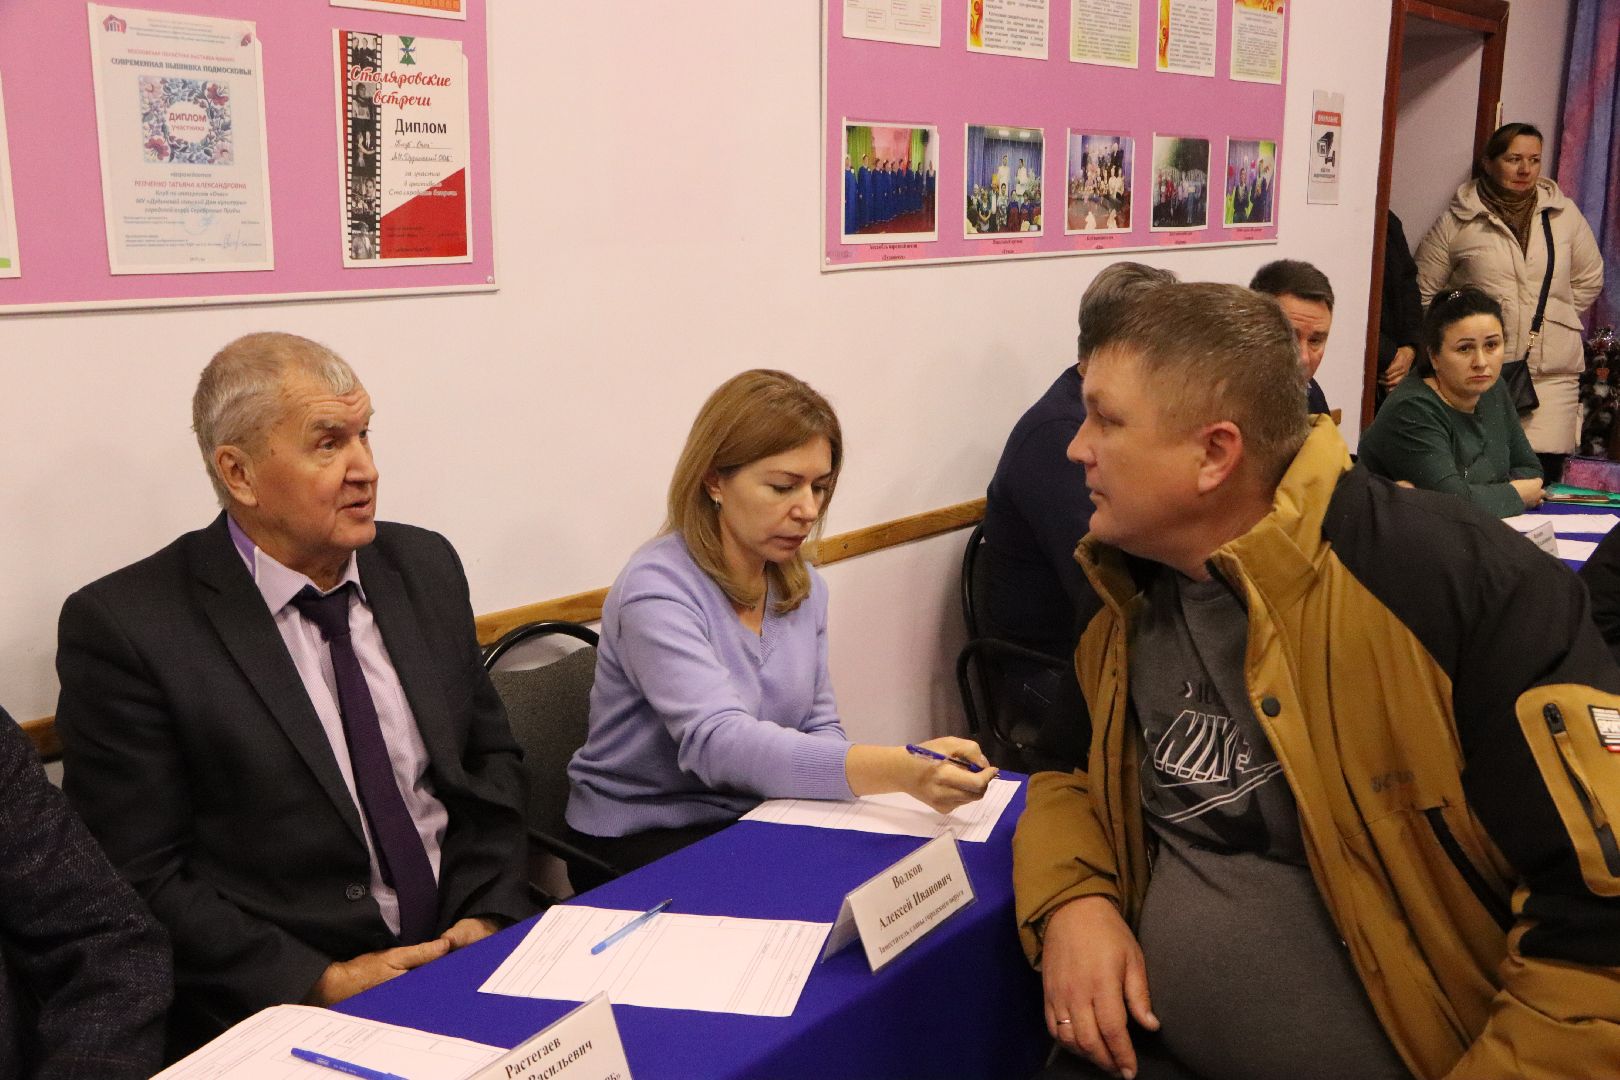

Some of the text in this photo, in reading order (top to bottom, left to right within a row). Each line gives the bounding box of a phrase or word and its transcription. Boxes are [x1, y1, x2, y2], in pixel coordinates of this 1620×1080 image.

[111, 57, 252, 76] СОВРЕМЕННАЯ ВЫШИВКА ПОДМОСКОВЬЯ
[350, 65, 451, 88] Столяровские
[373, 90, 431, 110] встречи
[169, 112, 207, 122] ДИПЛОМ
[395, 119, 447, 136] Диплом
[891, 863, 923, 889] Волков
[879, 873, 953, 931] Алексей Иванович
[504, 1037, 561, 1079] Растегаев
